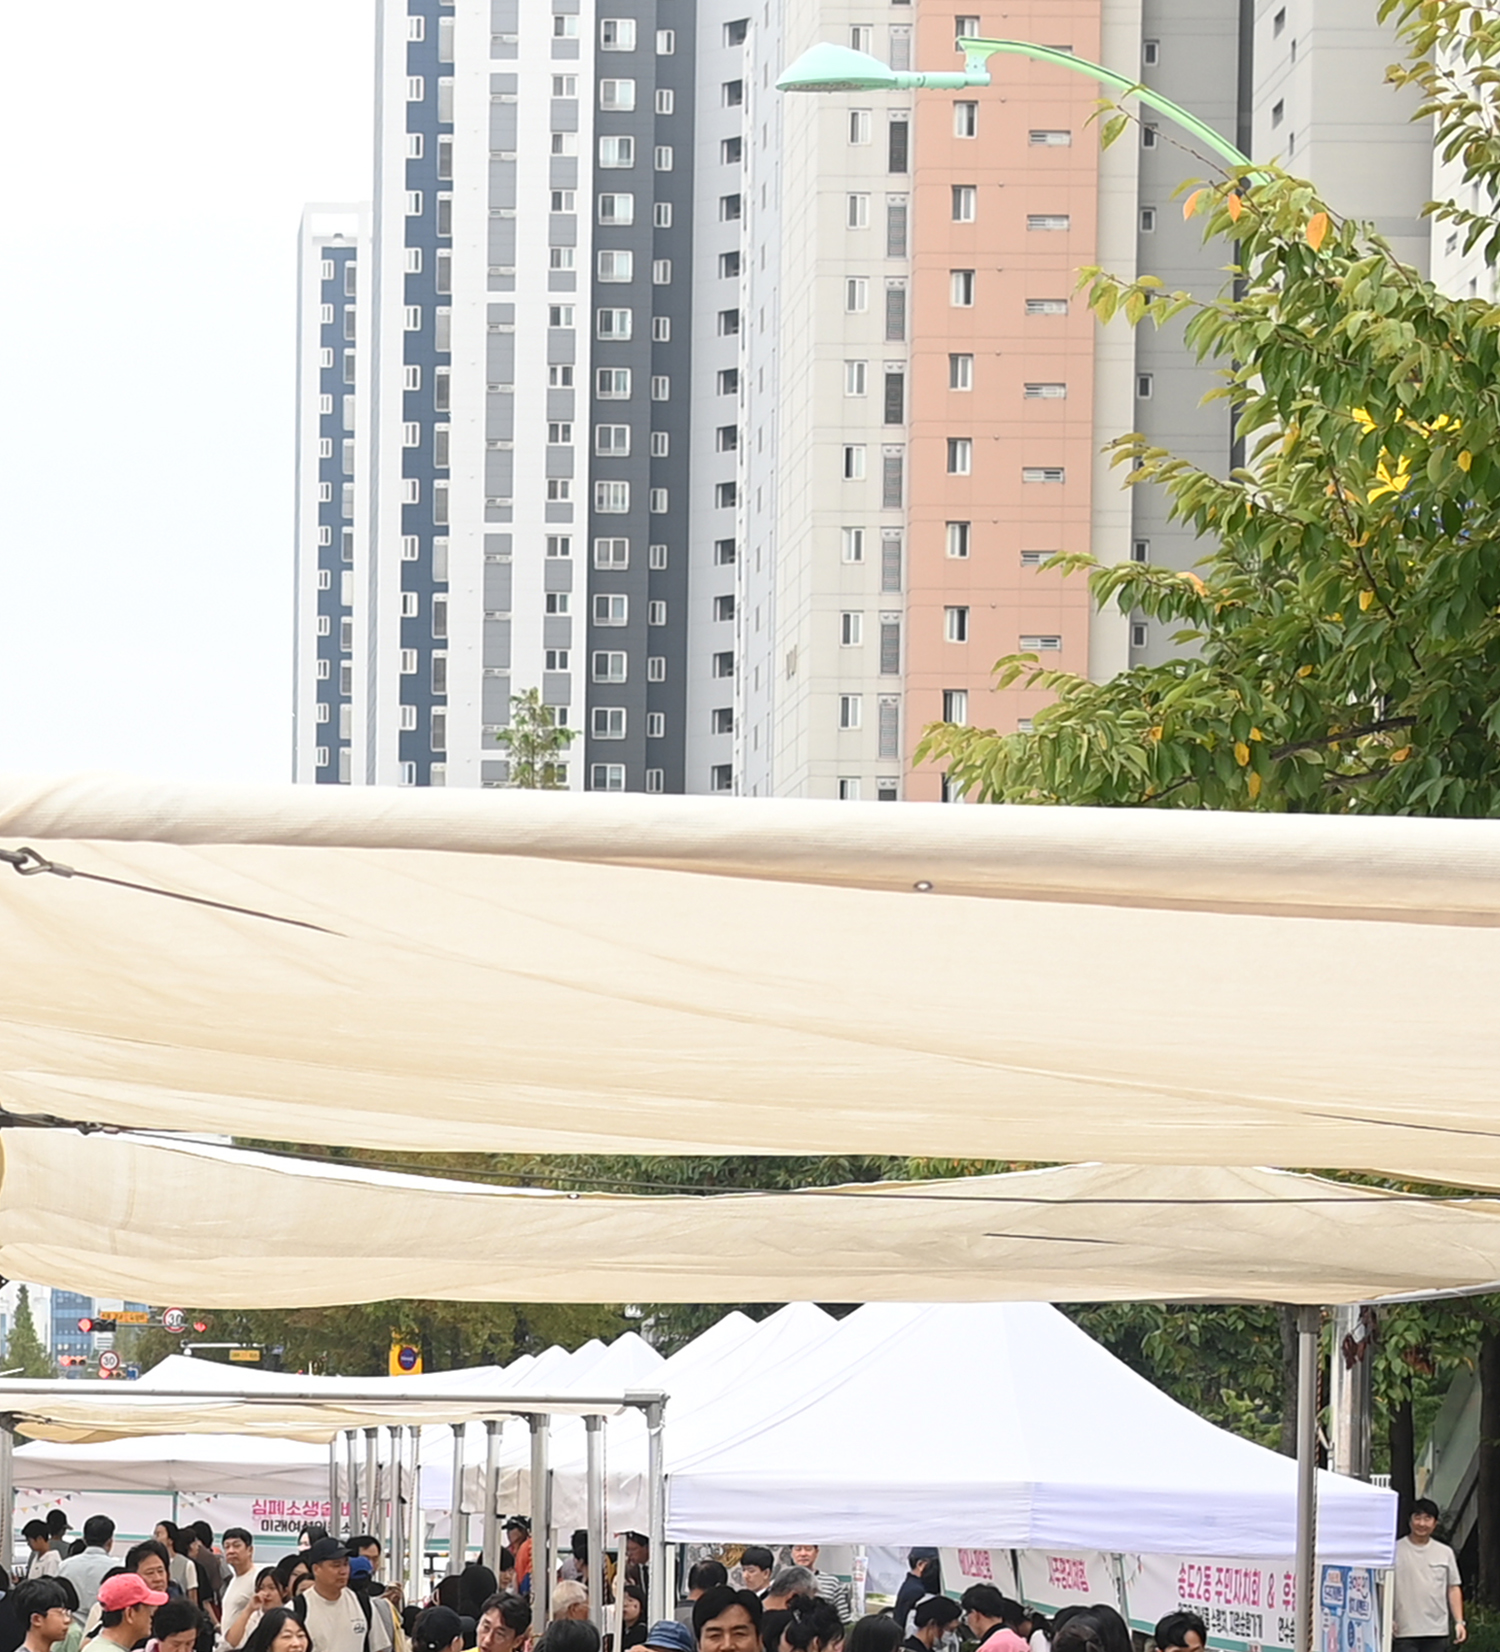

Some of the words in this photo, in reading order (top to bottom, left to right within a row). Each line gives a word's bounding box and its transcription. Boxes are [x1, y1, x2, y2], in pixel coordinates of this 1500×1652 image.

[168, 1313, 184, 1327] 30
[102, 1355, 116, 1367] 30
[251, 1499, 332, 1518] 심폐소생술
[1177, 1562, 1211, 1602] 송도2동
[1215, 1566, 1261, 1608] 주민자치회
[1267, 1572, 1276, 1609] &
